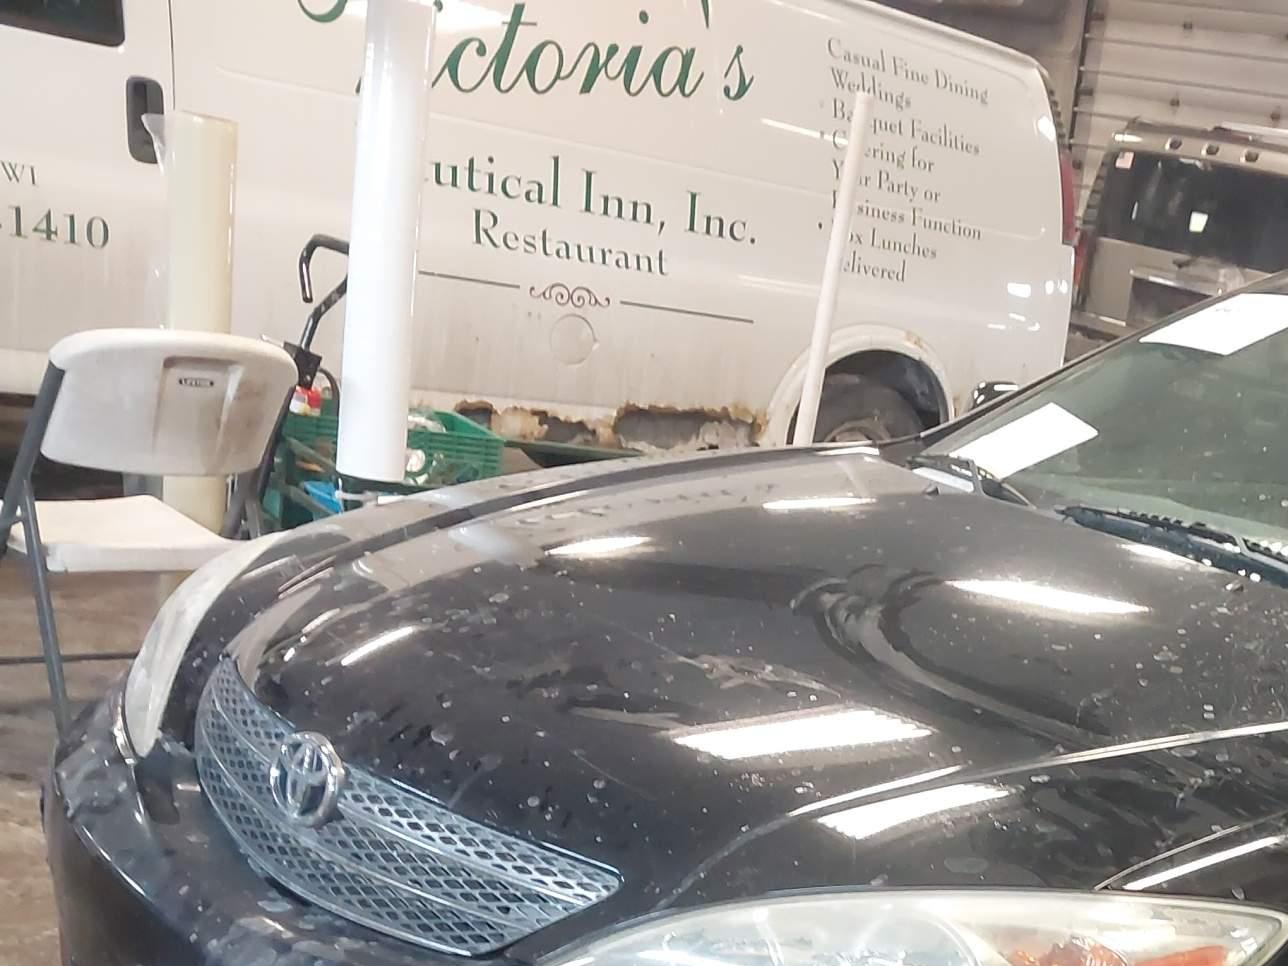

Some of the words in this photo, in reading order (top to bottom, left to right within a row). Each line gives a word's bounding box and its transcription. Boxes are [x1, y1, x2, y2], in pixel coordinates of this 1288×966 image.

[298, 0, 755, 101] ctoria's
[827, 36, 886, 73] Casual
[892, 55, 929, 85] Fine
[935, 68, 989, 105] Dining
[831, 66, 912, 112] Weddings
[911, 119, 981, 155] Facilities
[911, 146, 935, 173] for
[425, 155, 561, 207] utical
[578, 168, 667, 236] Inn,
[684, 190, 757, 245] Inc.
[878, 170, 919, 202] Party
[924, 188, 942, 203] or
[472, 207, 669, 276] Restaurant
[870, 227, 938, 260] Lunches
[911, 206, 982, 241] Function
